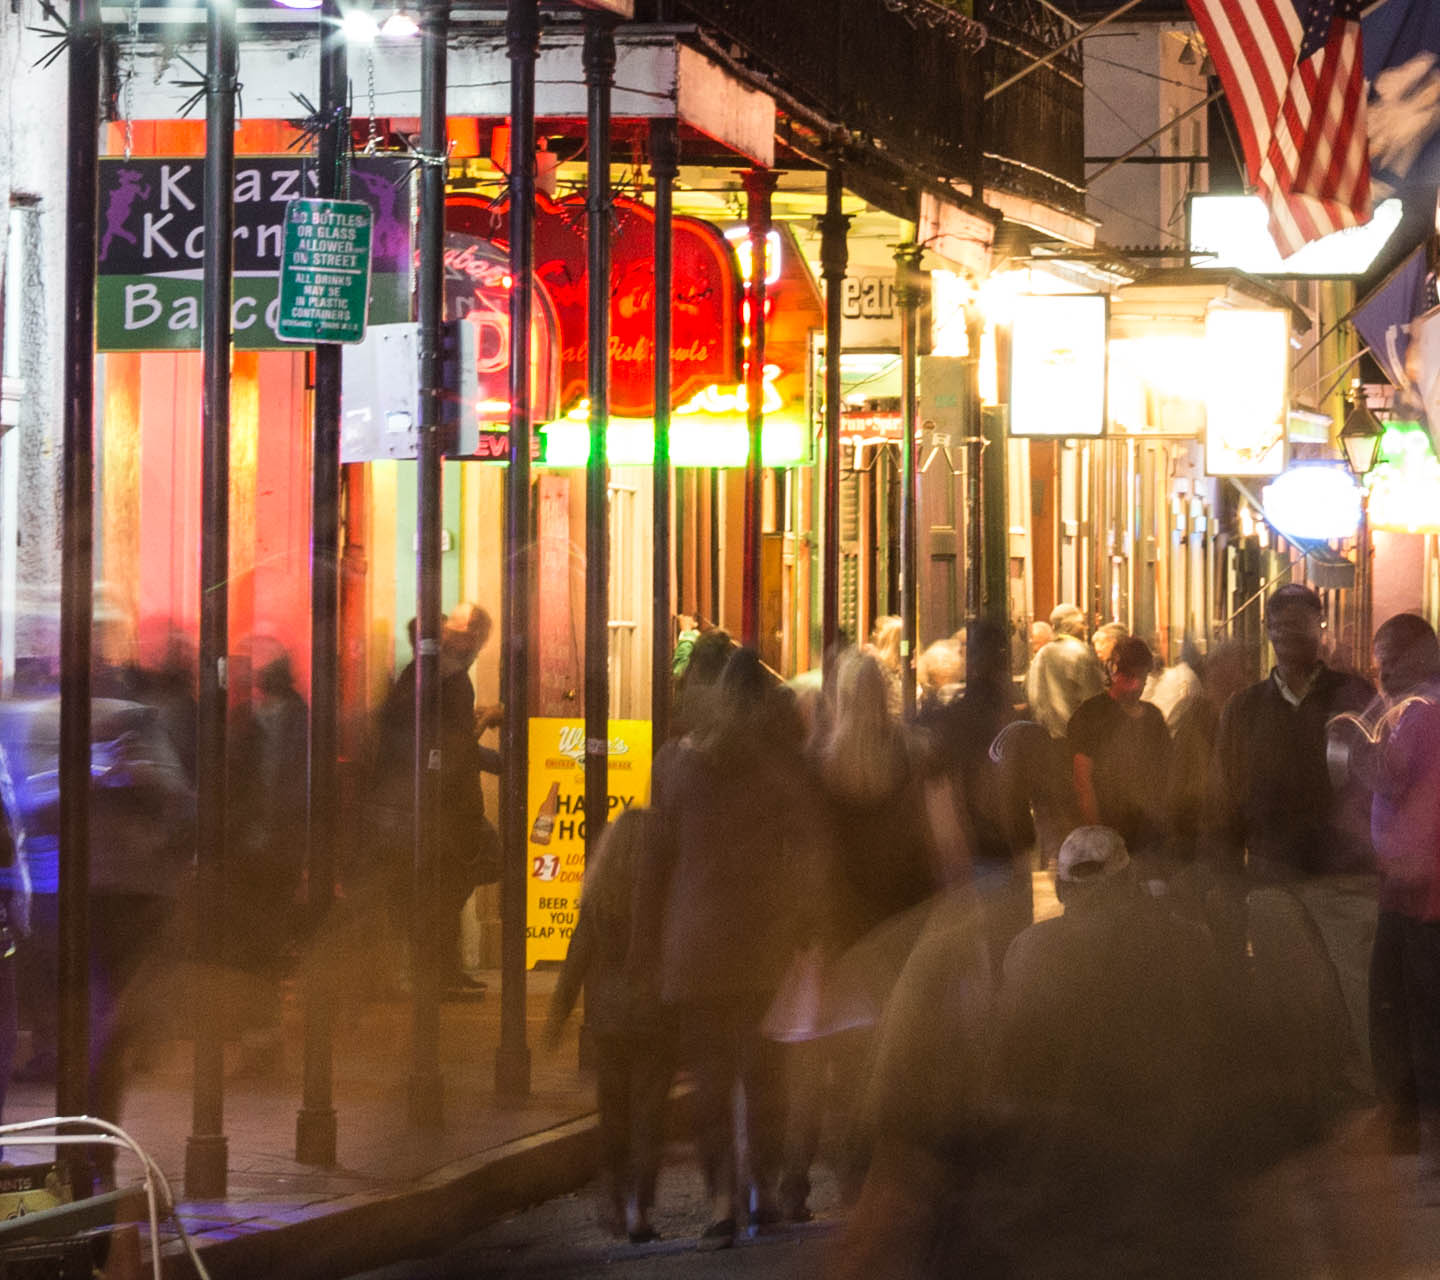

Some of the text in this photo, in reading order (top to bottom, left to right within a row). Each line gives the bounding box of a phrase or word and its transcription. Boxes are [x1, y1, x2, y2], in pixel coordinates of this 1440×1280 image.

[297, 226, 356, 240] OR GLASS
[299, 240, 354, 253] ALLOWED
[293, 253, 358, 267] ON STREET
[295, 273, 352, 287] ALL DRINKS
[303, 286, 341, 297] MAY BE
[295, 297, 349, 309] IN PLASTIC
[291, 308, 351, 321] CONTAINERS
[555, 794, 635, 814] HAPY
[539, 897, 568, 910] BEER
[550, 912, 574, 925] YOU
[527, 927, 555, 939] SLAP
